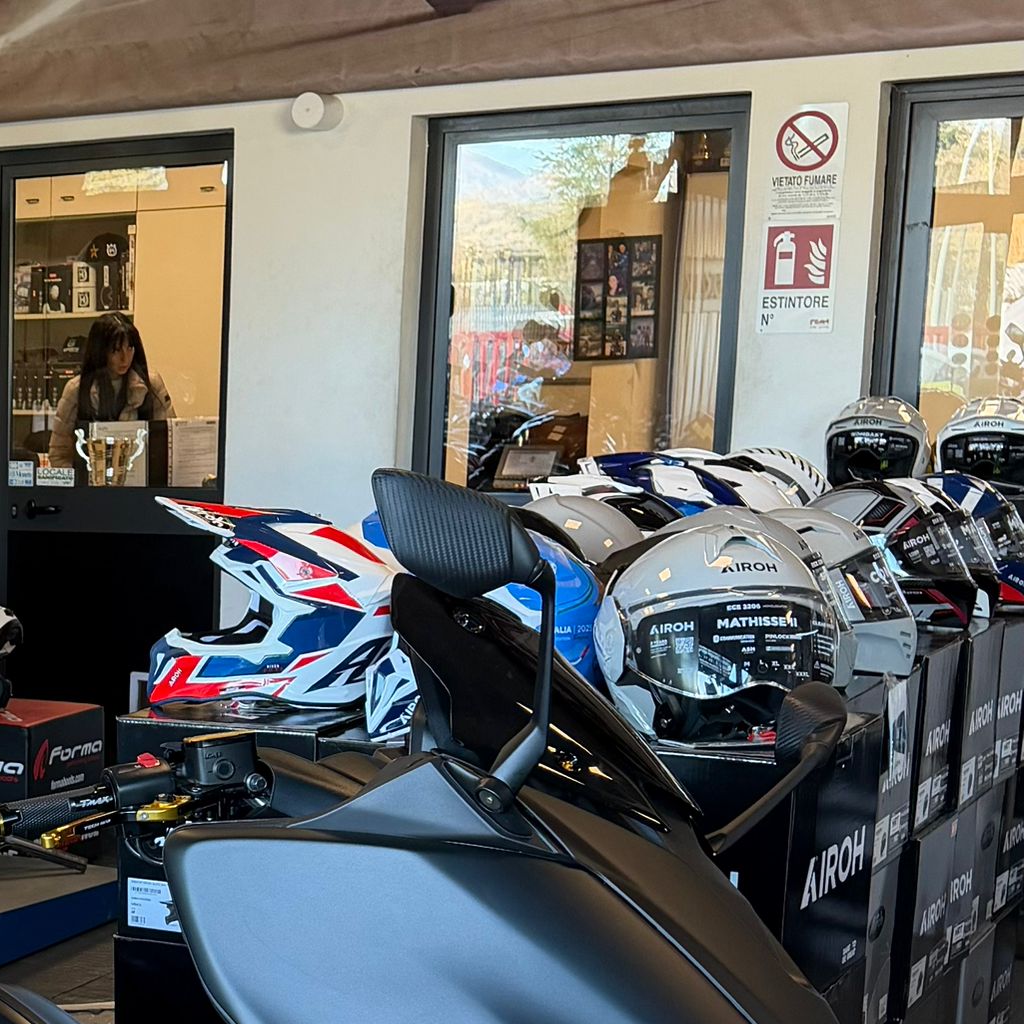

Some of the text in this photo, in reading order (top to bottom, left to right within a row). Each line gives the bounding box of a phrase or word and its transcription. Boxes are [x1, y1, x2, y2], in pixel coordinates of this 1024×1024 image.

[772, 174, 838, 187] VIETATO FUMARE
[762, 296, 829, 309] ESTINTORE
[761, 313, 774, 326] N°
[853, 418, 883, 427] AIROH
[973, 420, 1005, 428] AIROH
[903, 533, 931, 551] AIROH
[721, 561, 778, 574] AIROH
[554, 626, 572, 634] ALIA
[650, 621, 694, 636] AIROH
[716, 616, 798, 629] MATHISSE II
[400, 695, 421, 725] AIR
[968, 700, 994, 736] AIROH
[925, 719, 951, 757] AIROH
[49, 739, 103, 766] Forma
[800, 825, 866, 910] AIROH
[949, 868, 973, 904] IROH
[919, 891, 947, 937] AIROH
